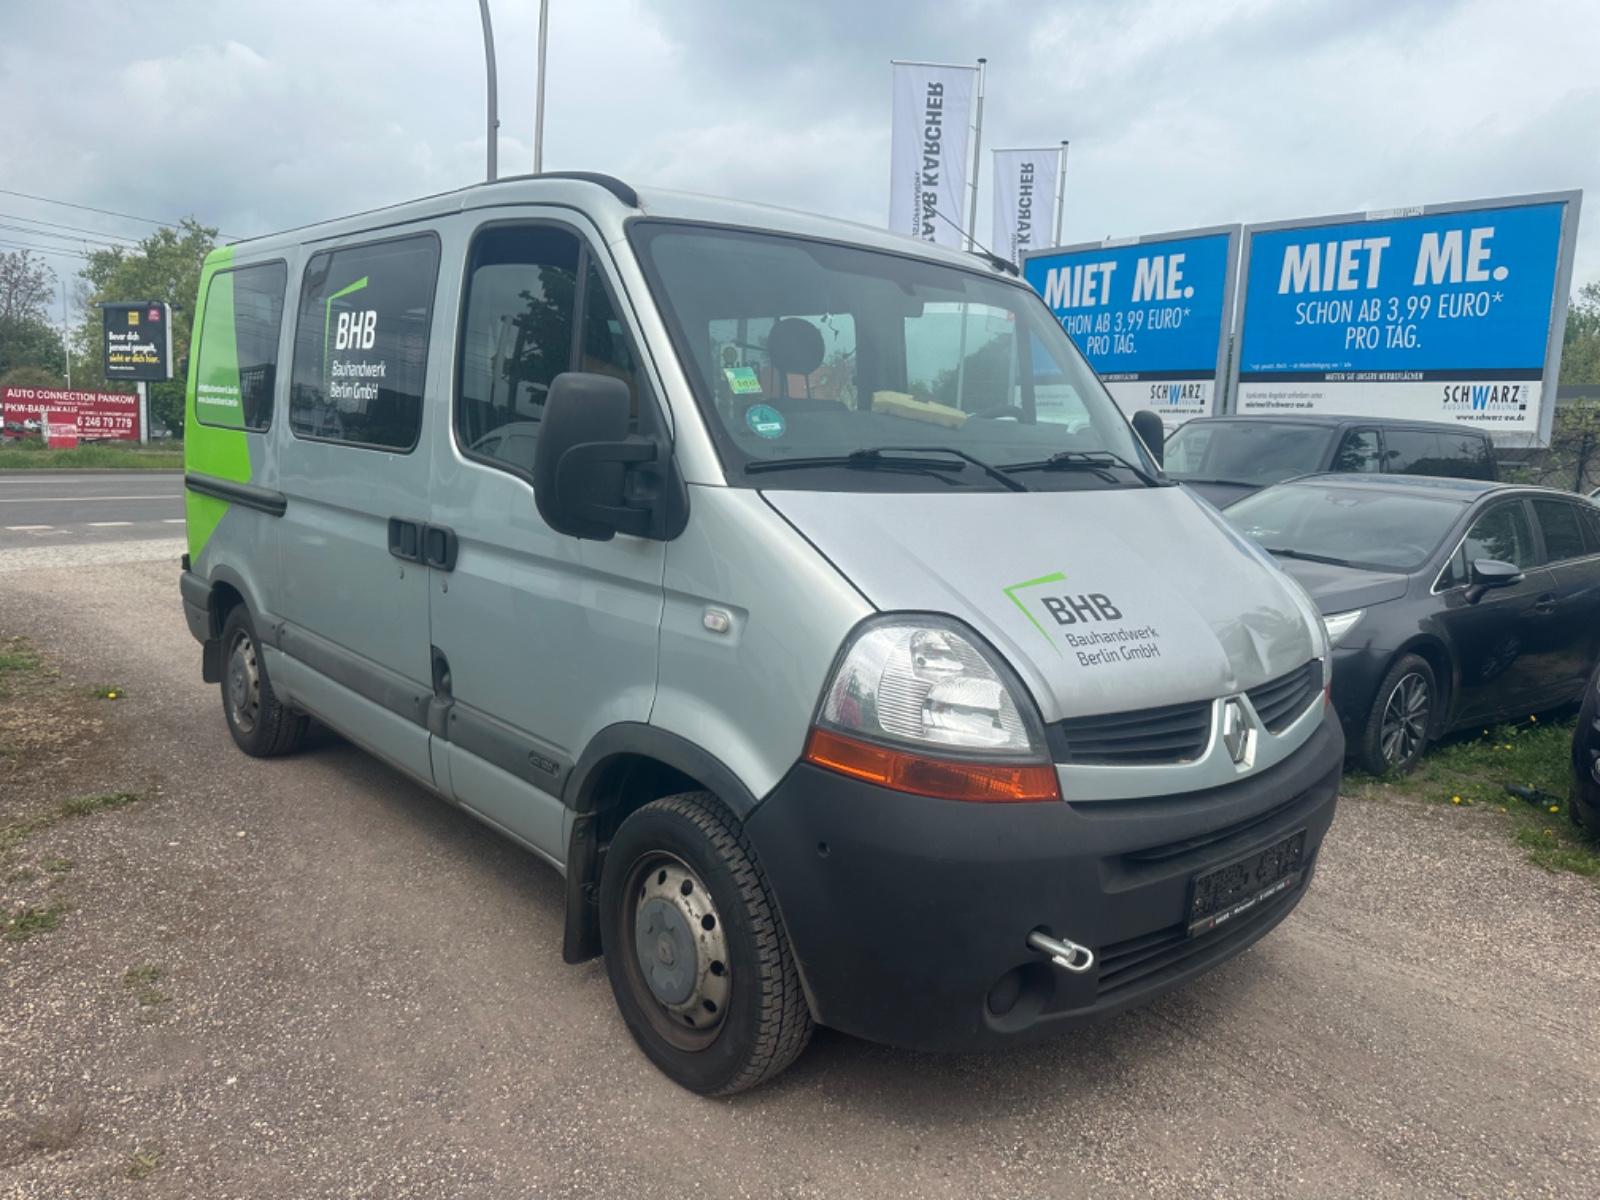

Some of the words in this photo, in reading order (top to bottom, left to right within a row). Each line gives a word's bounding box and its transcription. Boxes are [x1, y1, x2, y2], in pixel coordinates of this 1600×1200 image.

[1278, 236, 1391, 295] MIET
[1412, 227, 1509, 286] ME.
[1044, 261, 1117, 309] MIET
[1131, 253, 1194, 302] ME.
[1095, 313, 1111, 332] AB
[1114, 310, 1144, 333] 3,99
[1296, 299, 1353, 325] SCHON
[1358, 298, 1381, 323] AB
[1387, 295, 1431, 324] 3,99
[336, 310, 377, 350] BHB
[1345, 326, 1379, 350] PRO
[1386, 324, 1421, 349] TAG.
[1086, 336, 1109, 356] PRO
[1113, 333, 1137, 354] TAG.
[331, 360, 386, 377] Bauhandwerk
[7, 388, 35, 399] AUTO
[36, 390, 96, 402] CONNECTION
[98, 393, 136, 404] PANKOW
[330, 381, 353, 398] Berlin
[353, 382, 379, 399] GmbH
[1150, 384, 1201, 405] SCHWARZ
[1443, 385, 1520, 410] SCHWARZ
[1041, 593, 1123, 625] BHB
[1065, 625, 1160, 648] Bauhandwerk
[1076, 648, 1121, 667] Berlin
[1119, 643, 1161, 661] GmbH
